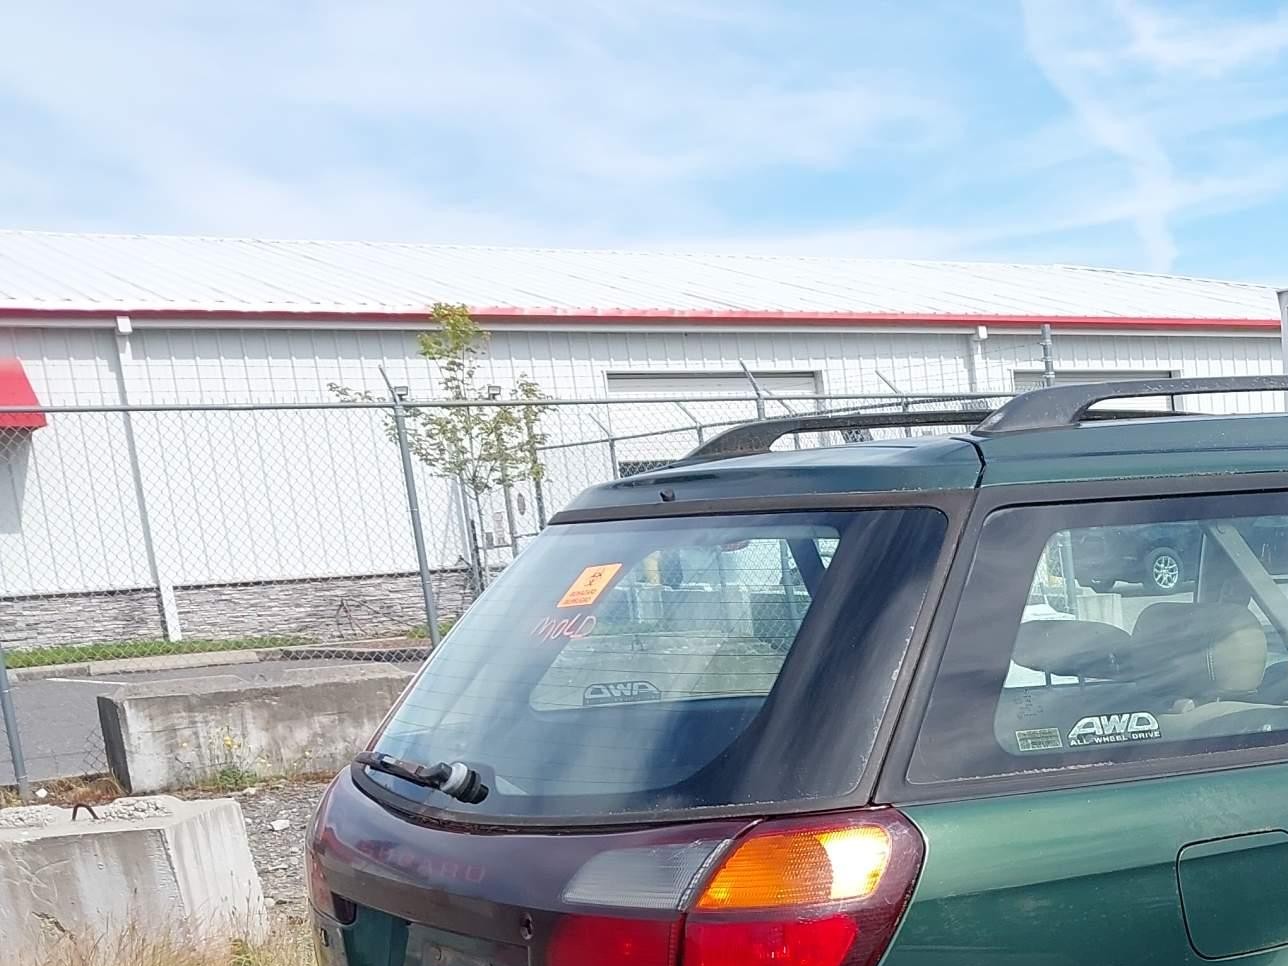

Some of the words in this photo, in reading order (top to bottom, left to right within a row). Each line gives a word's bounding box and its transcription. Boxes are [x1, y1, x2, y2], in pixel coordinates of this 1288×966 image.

[1068, 712, 1159, 738] AWD
[1070, 738, 1090, 746] ALL
[1093, 734, 1128, 744] WHEEL
[1132, 731, 1161, 740] DRIVE
